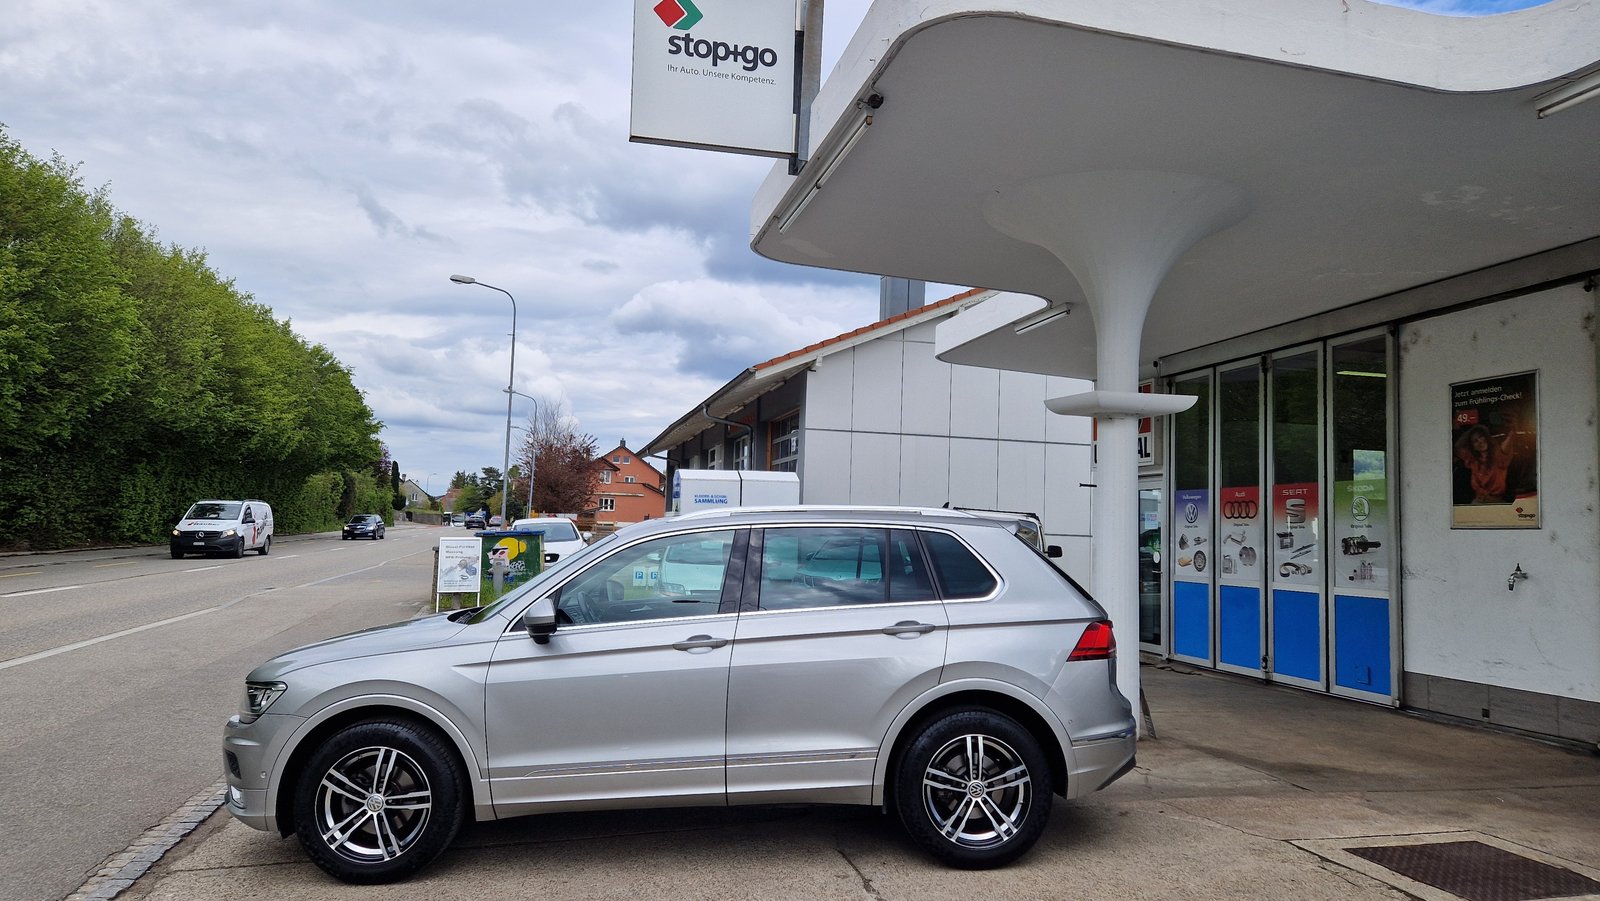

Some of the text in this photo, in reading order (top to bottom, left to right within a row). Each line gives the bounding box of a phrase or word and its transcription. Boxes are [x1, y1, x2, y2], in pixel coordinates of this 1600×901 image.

[667, 33, 778, 72] stop+go
[667, 64, 777, 86] Ihr Auto. Unsere Kompetenz.
[1454, 386, 1503, 399] Jetzt anmelden
[1454, 400, 1468, 408] zum
[1282, 488, 1309, 496] SEAT
